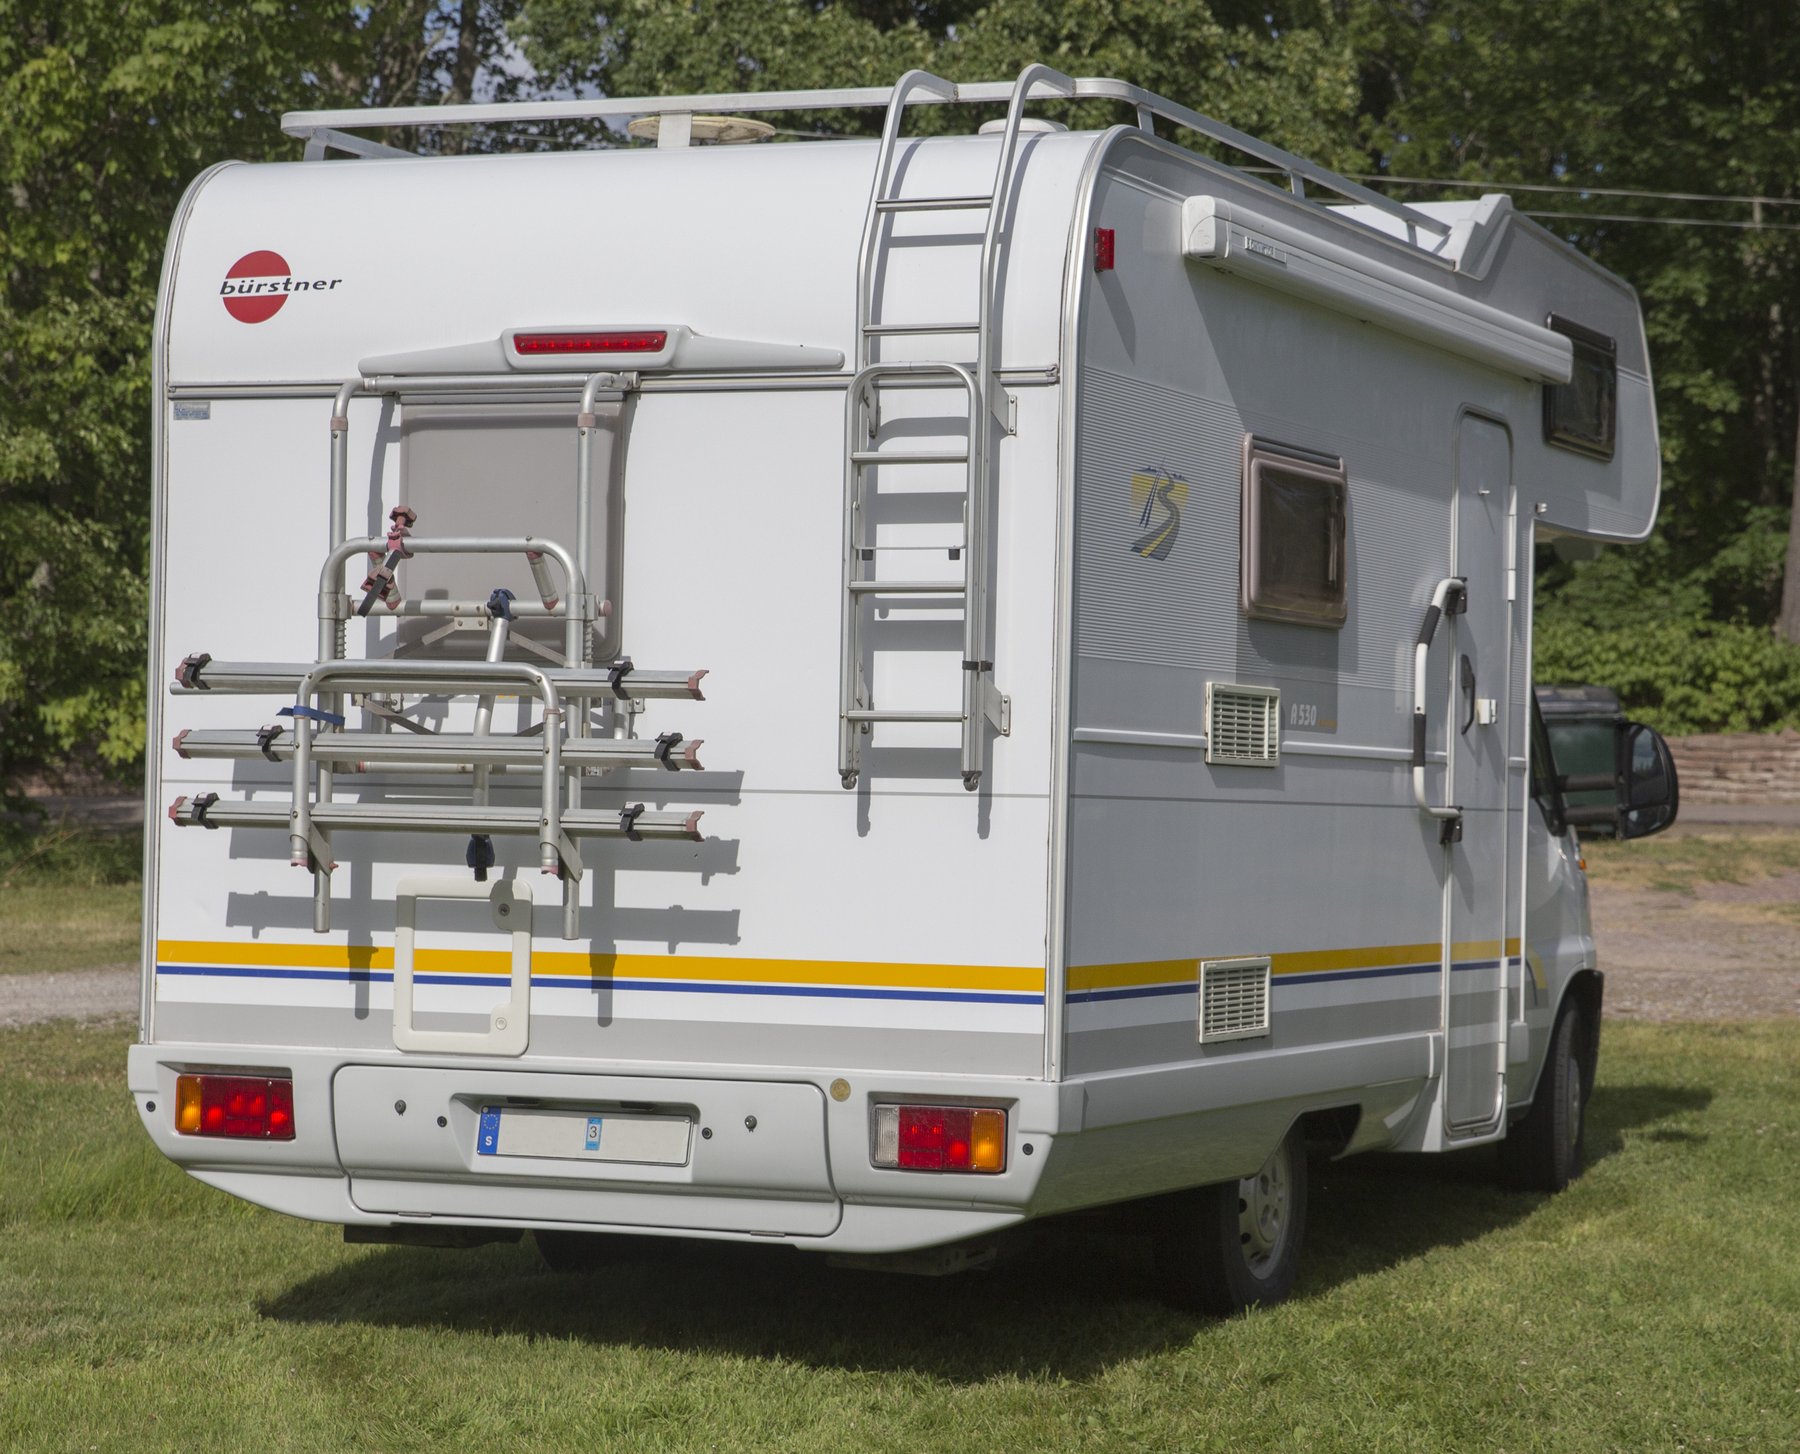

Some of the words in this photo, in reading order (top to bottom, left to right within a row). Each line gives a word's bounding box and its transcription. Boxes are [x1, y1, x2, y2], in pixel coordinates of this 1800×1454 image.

[220, 278, 342, 295] bürstner
[589, 1125, 598, 1138] 3
[485, 1136, 493, 1146] S
